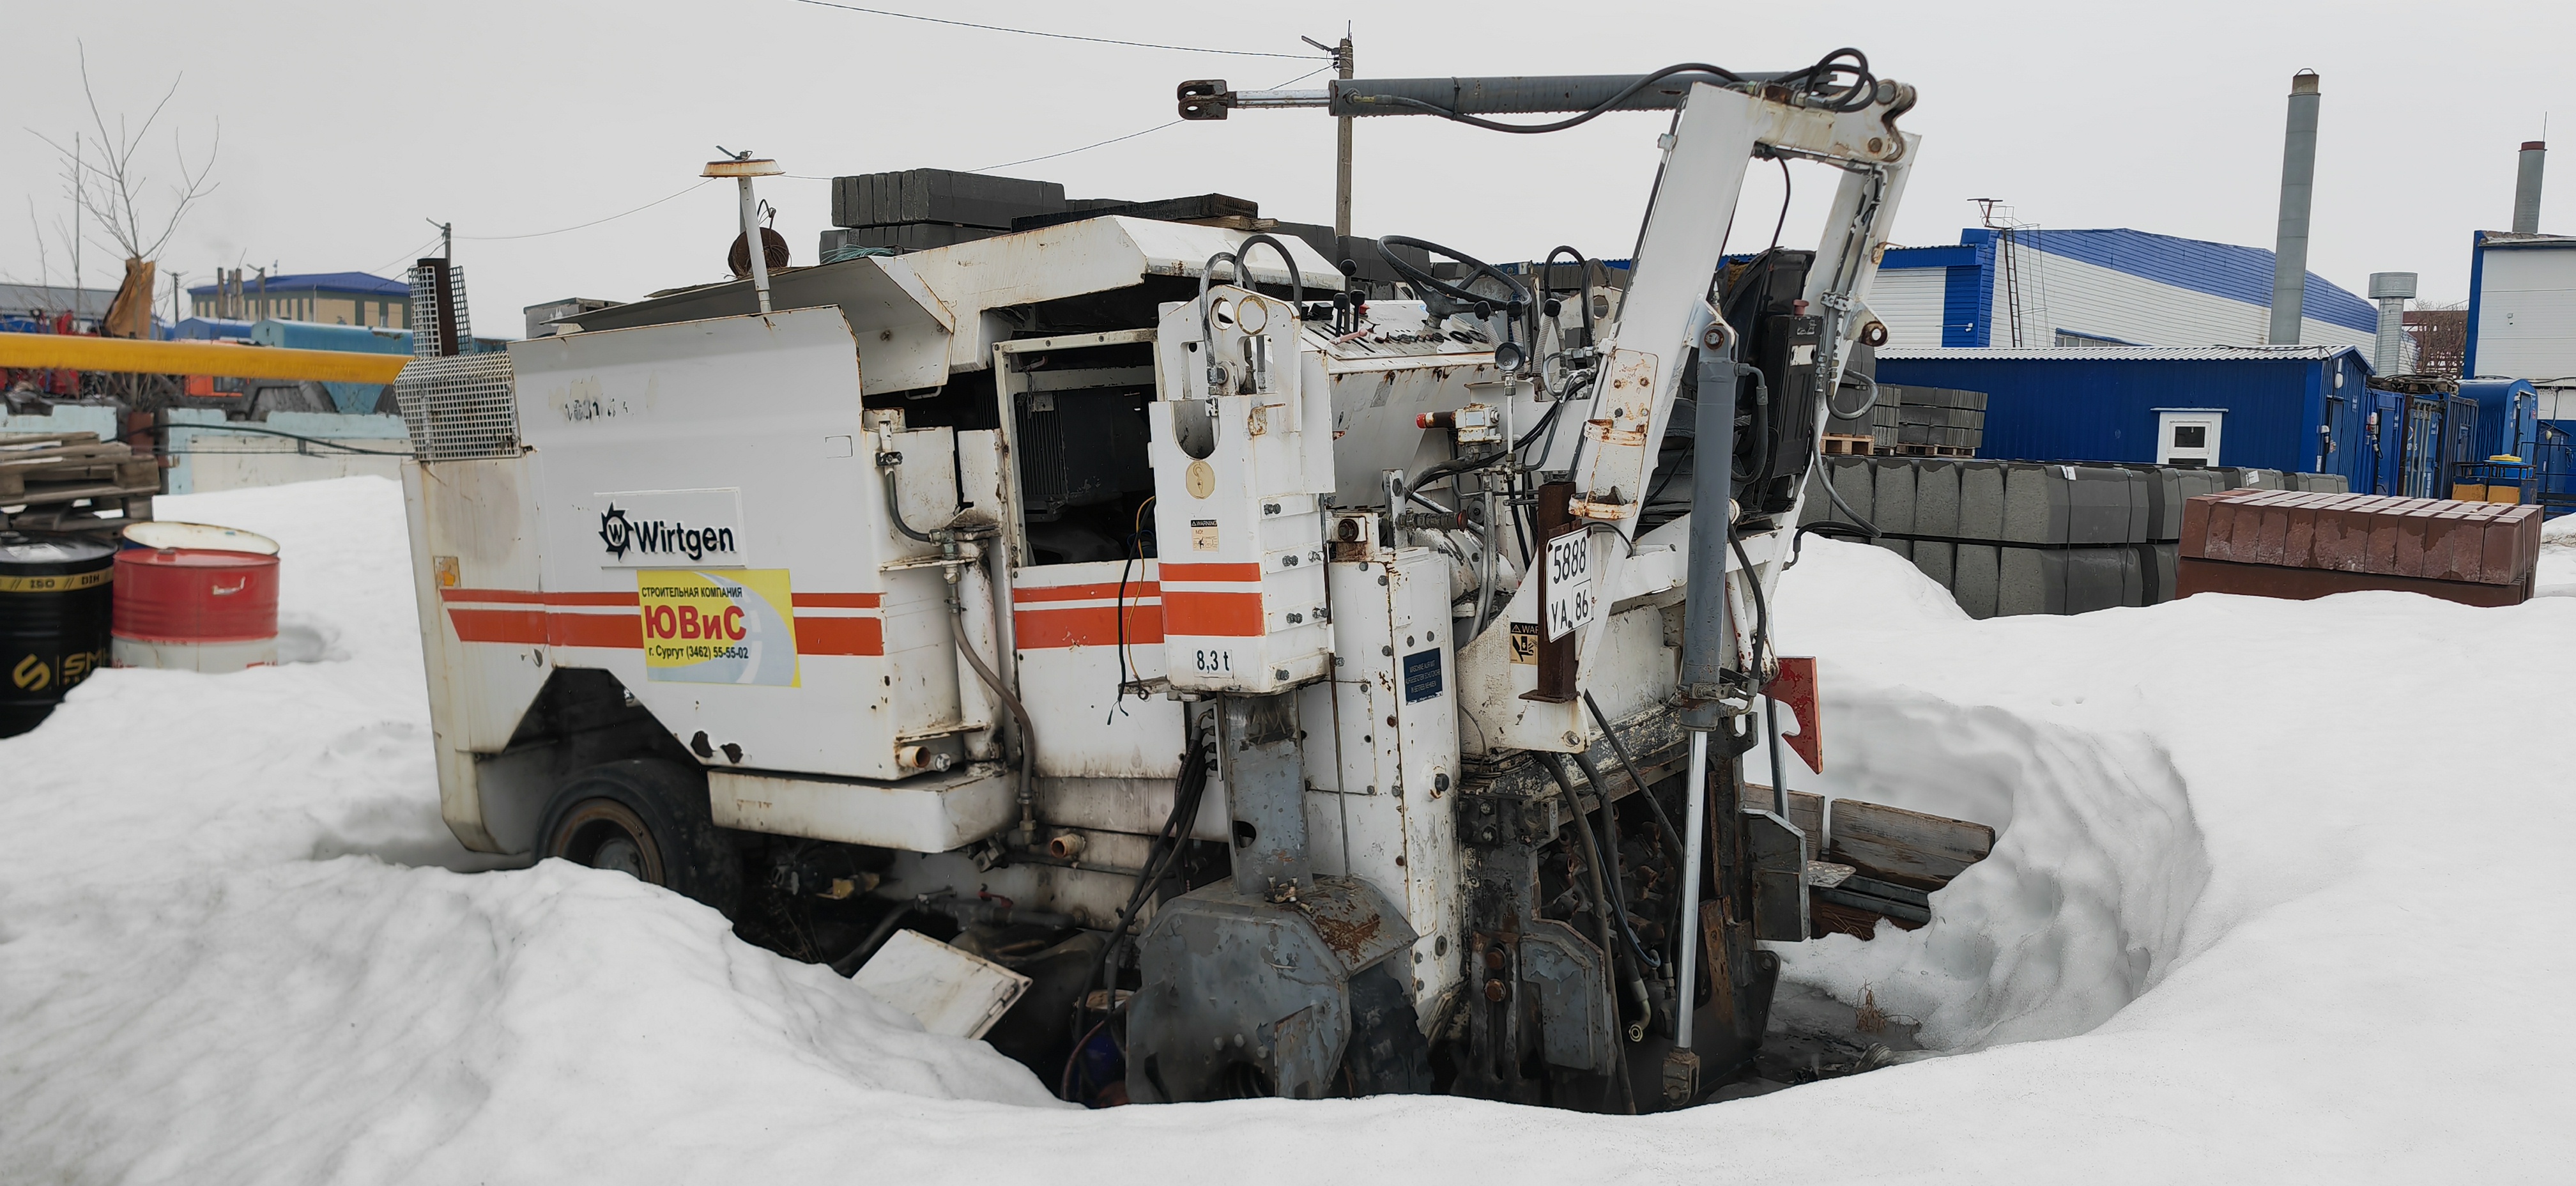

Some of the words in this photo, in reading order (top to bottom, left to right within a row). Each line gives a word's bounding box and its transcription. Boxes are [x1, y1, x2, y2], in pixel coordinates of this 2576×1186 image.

[634, 520, 734, 560] Wirtgen
[1553, 536, 1586, 584] 5888
[30, 579, 55, 589] ISO
[641, 587, 699, 598] СТРОИТЕЛЬНАЯ
[701, 587, 743, 598] КОМПАНИЯ
[1575, 589, 1588, 621] 86
[644, 605, 747, 641] ЮВиС
[648, 647, 654, 656] г.
[656, 645, 684, 660] Сургут
[686, 645, 711, 661] (3462)
[713, 646, 749, 659] 55-55-02
[1197, 650, 1218, 674] 8,3
[1223, 651, 1230, 672] t
